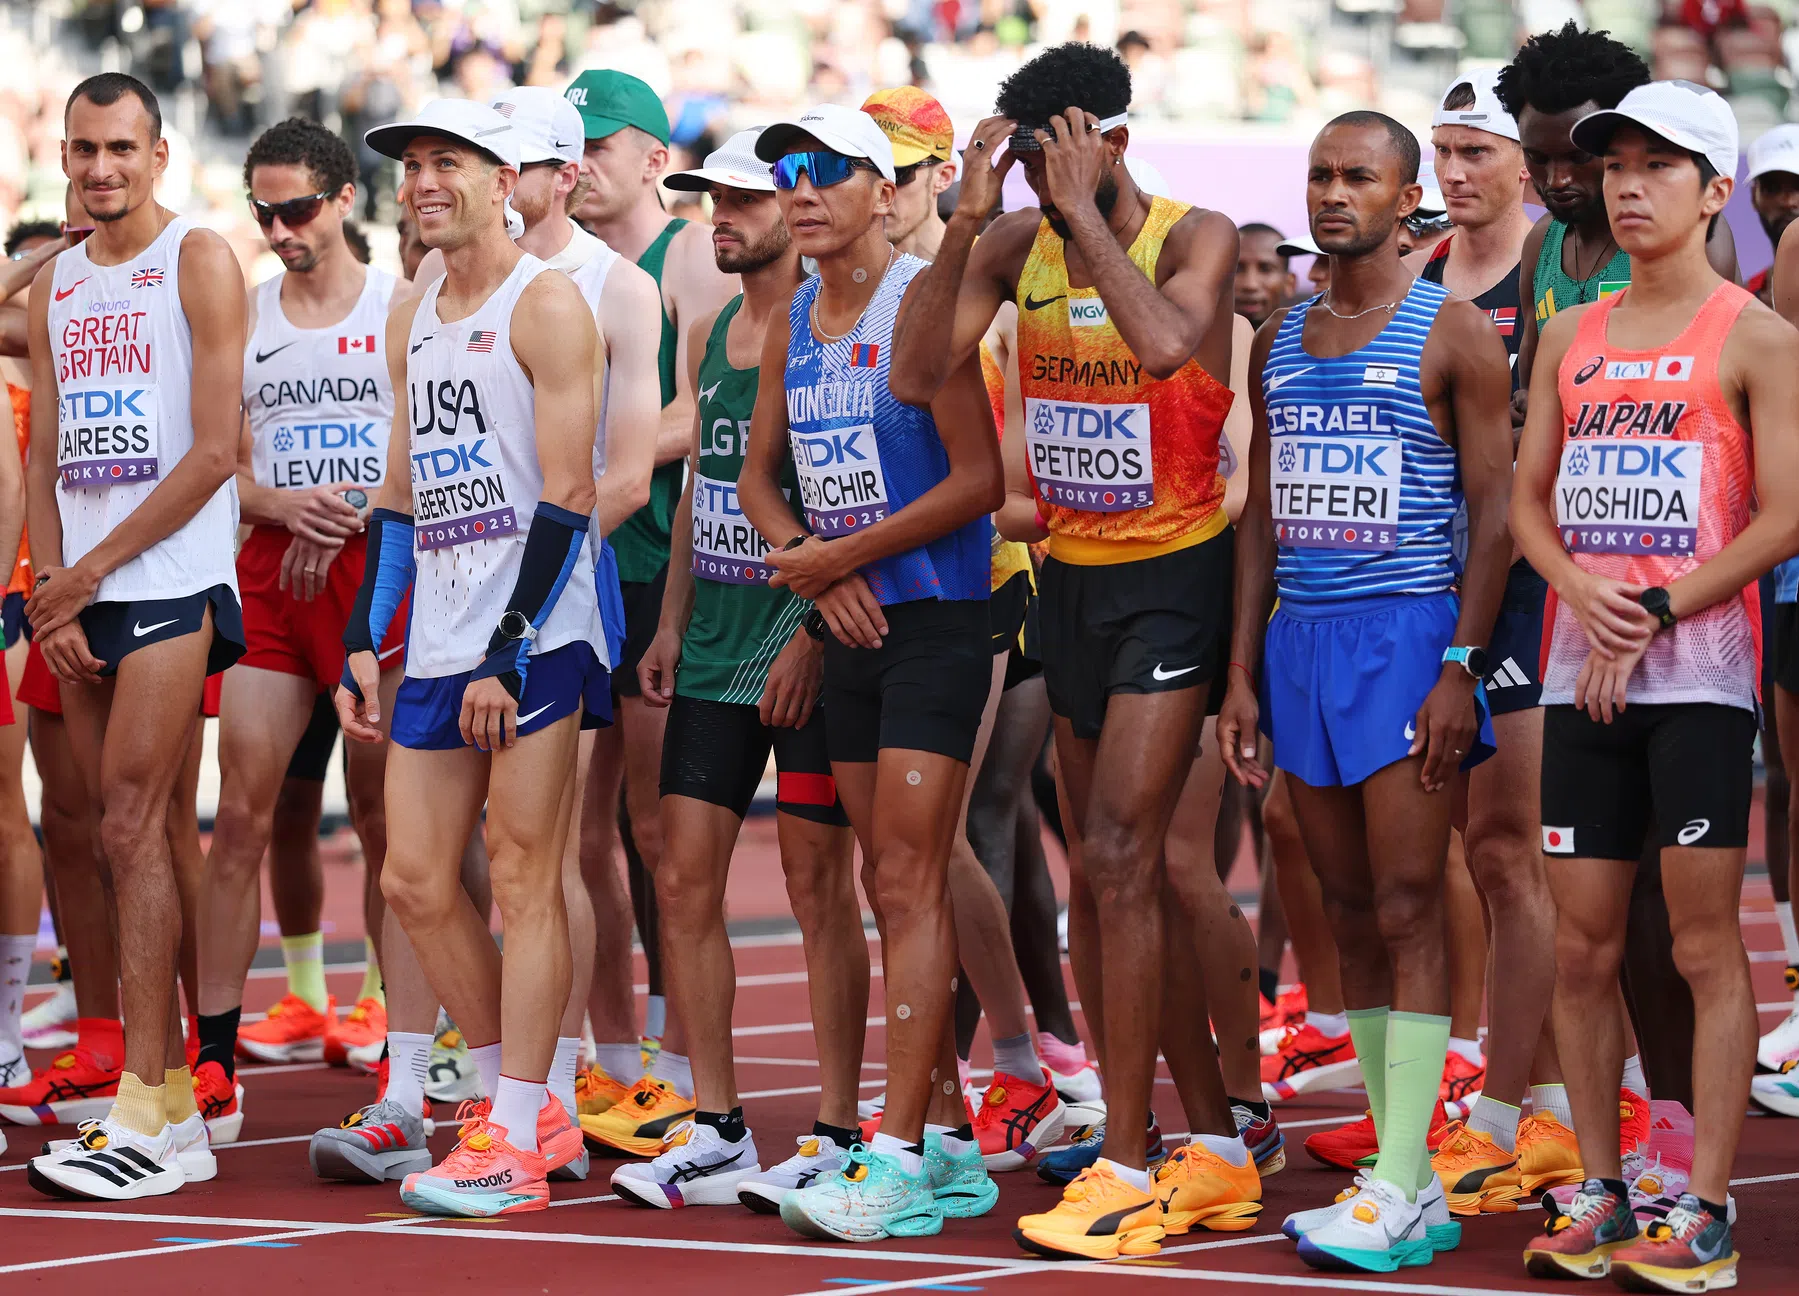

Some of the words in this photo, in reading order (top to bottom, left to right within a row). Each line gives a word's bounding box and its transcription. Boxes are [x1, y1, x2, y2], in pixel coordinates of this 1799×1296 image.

[566, 87, 588, 106] IRL
[873, 118, 902, 133] MANY
[1070, 305, 1106, 320] WGV
[63, 312, 147, 349] GREAT
[60, 343, 151, 383] BRITAIN
[1032, 354, 1143, 387] GERMANY
[1607, 363, 1651, 378] ACN
[65, 389, 146, 421] TDK
[259, 378, 379, 408] CANADA
[411, 379, 487, 436] USA
[786, 381, 874, 425] MONGOLIA
[293, 423, 378, 450] TDK
[1055, 406, 1138, 439] TDK
[1268, 404, 1392, 435] ISRAEL
[1567, 401, 1688, 439] JAPAN
[59, 424, 150, 461] CAIRESS
[798, 430, 868, 468] TDK
[1297, 442, 1389, 476] TDK
[274, 457, 381, 488] LEVINS
[412, 438, 493, 482] TDK
[1033, 442, 1143, 481] PETROS
[1591, 445, 1687, 479] TDK
[703, 482, 745, 516] TD
[1275, 483, 1389, 519] TEFERI
[1562, 486, 1689, 523] YOSHIDA
[453, 1168, 513, 1189] BROOKS
